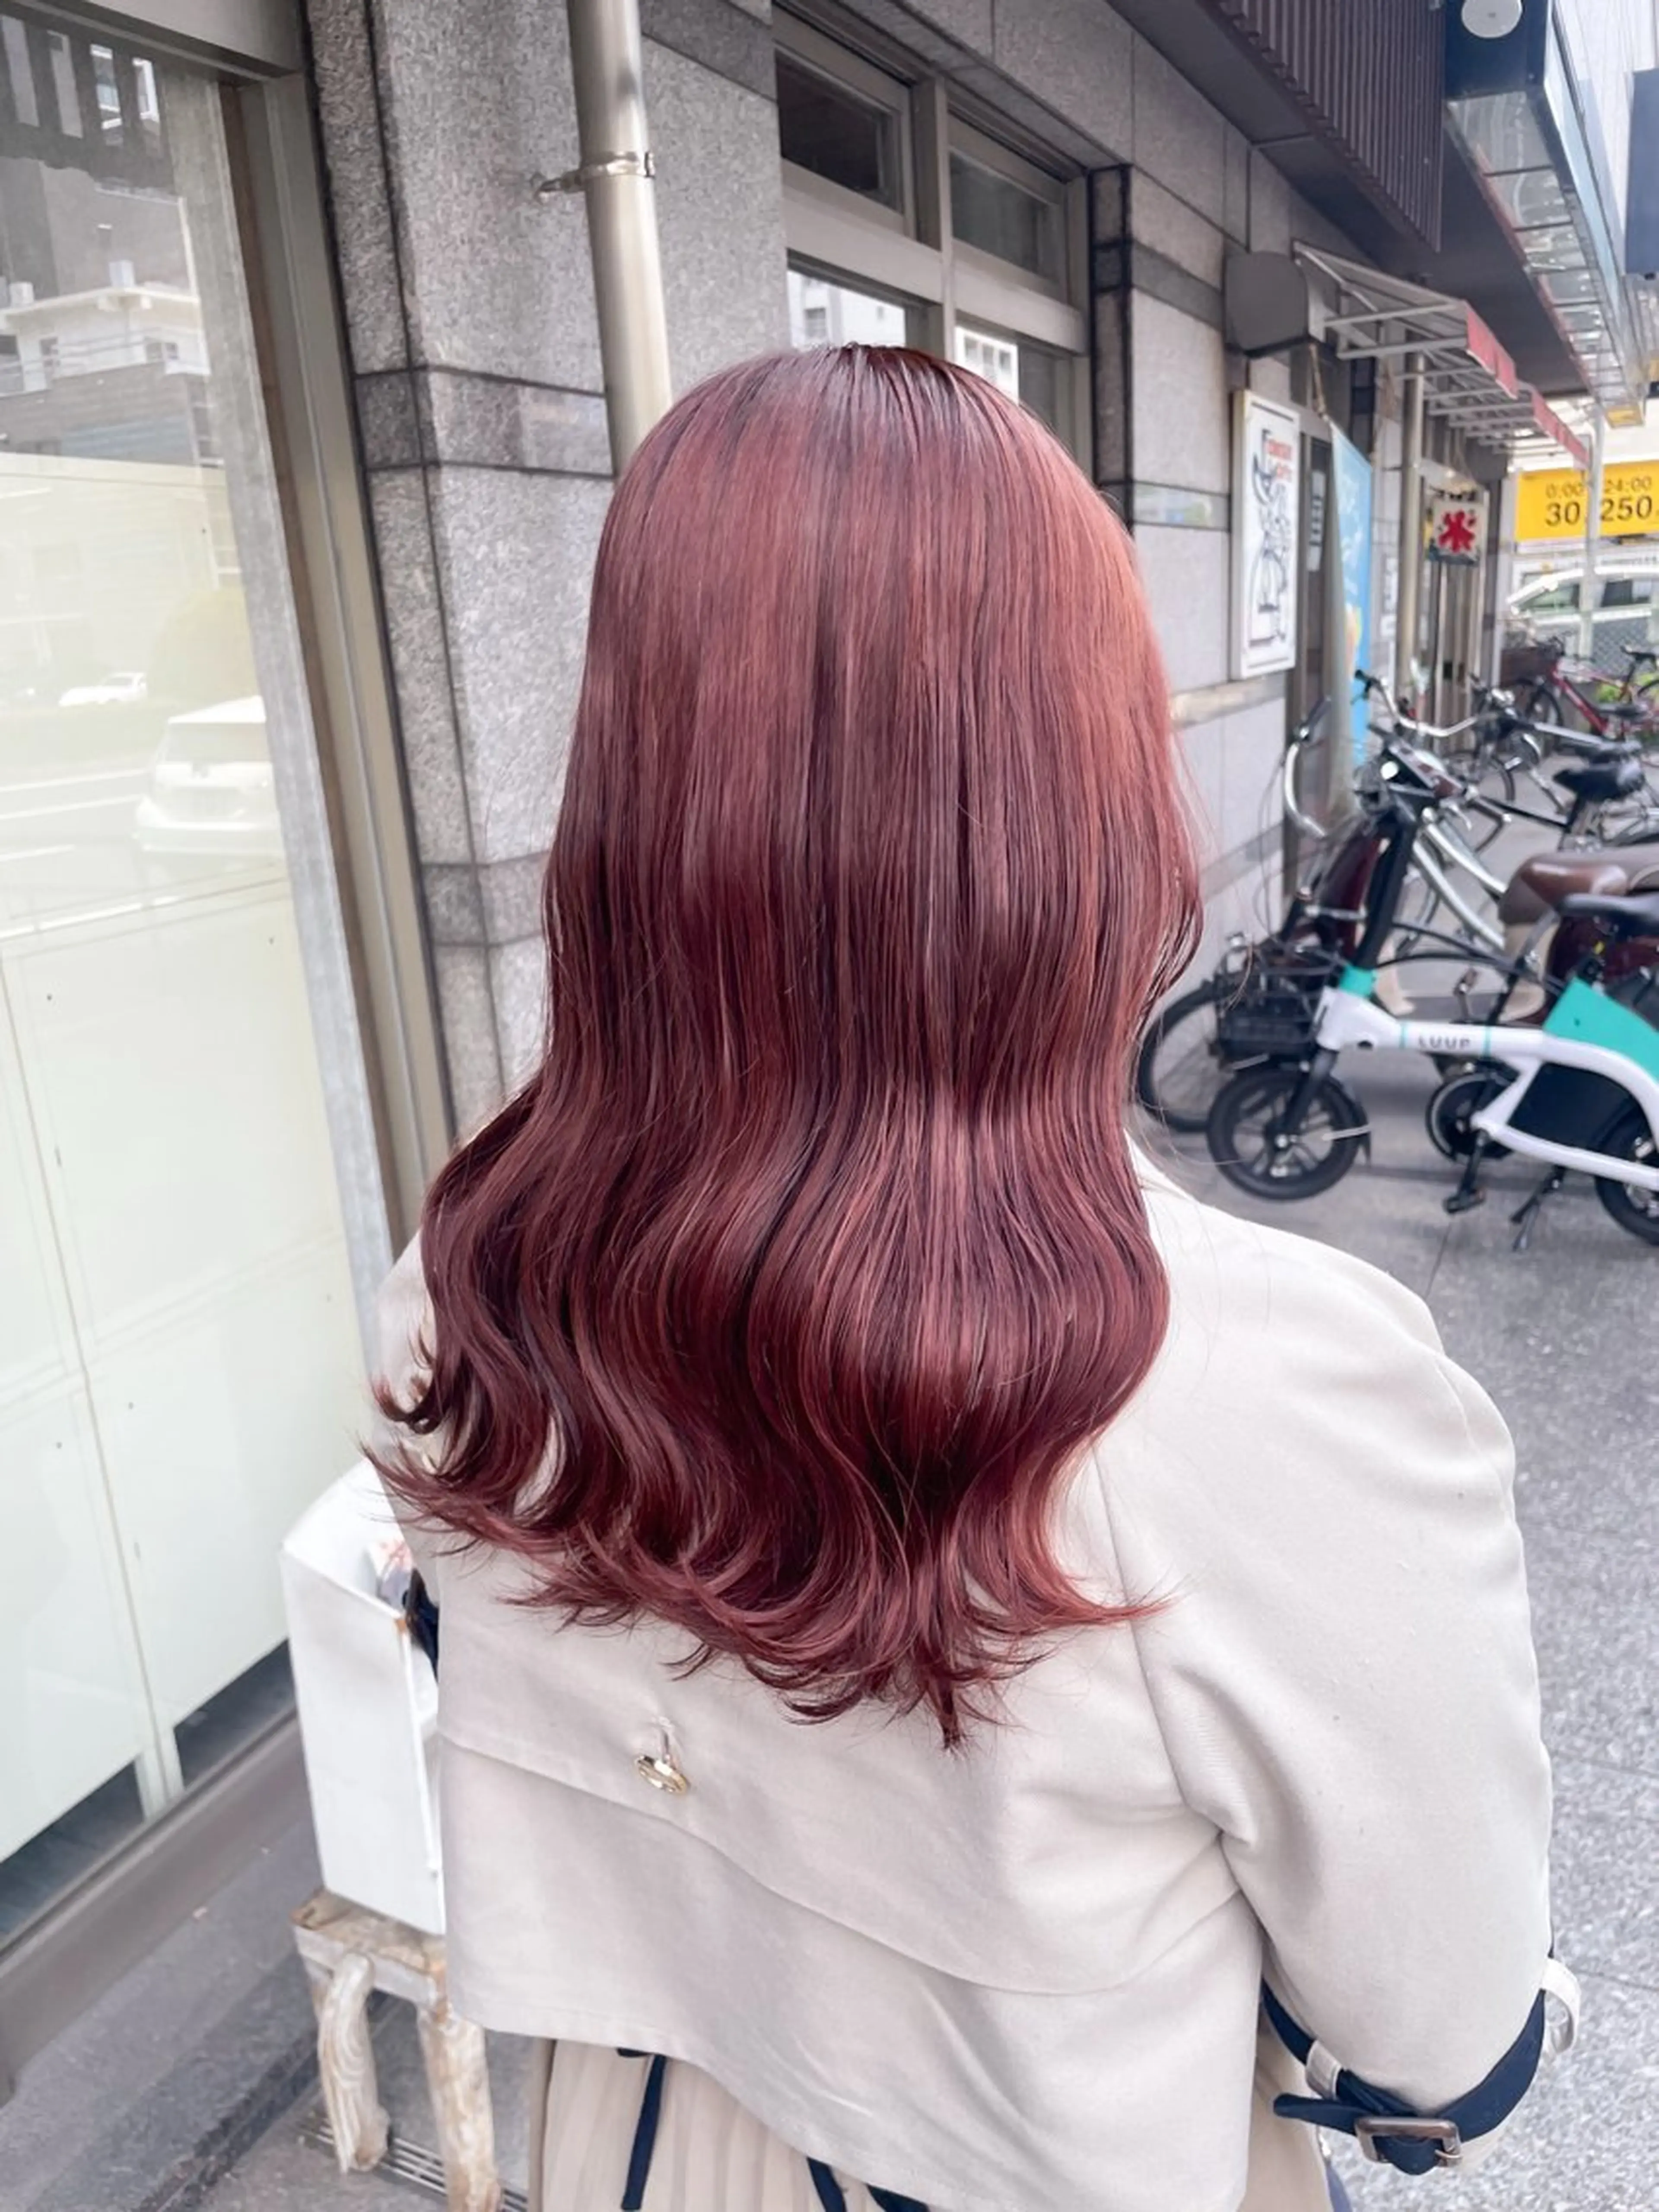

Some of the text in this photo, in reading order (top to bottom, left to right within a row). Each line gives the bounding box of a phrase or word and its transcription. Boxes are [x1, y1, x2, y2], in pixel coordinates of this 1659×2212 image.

[1545, 496, 1652, 527] 30 250
[1419, 1035, 1471, 1049] LUUP
